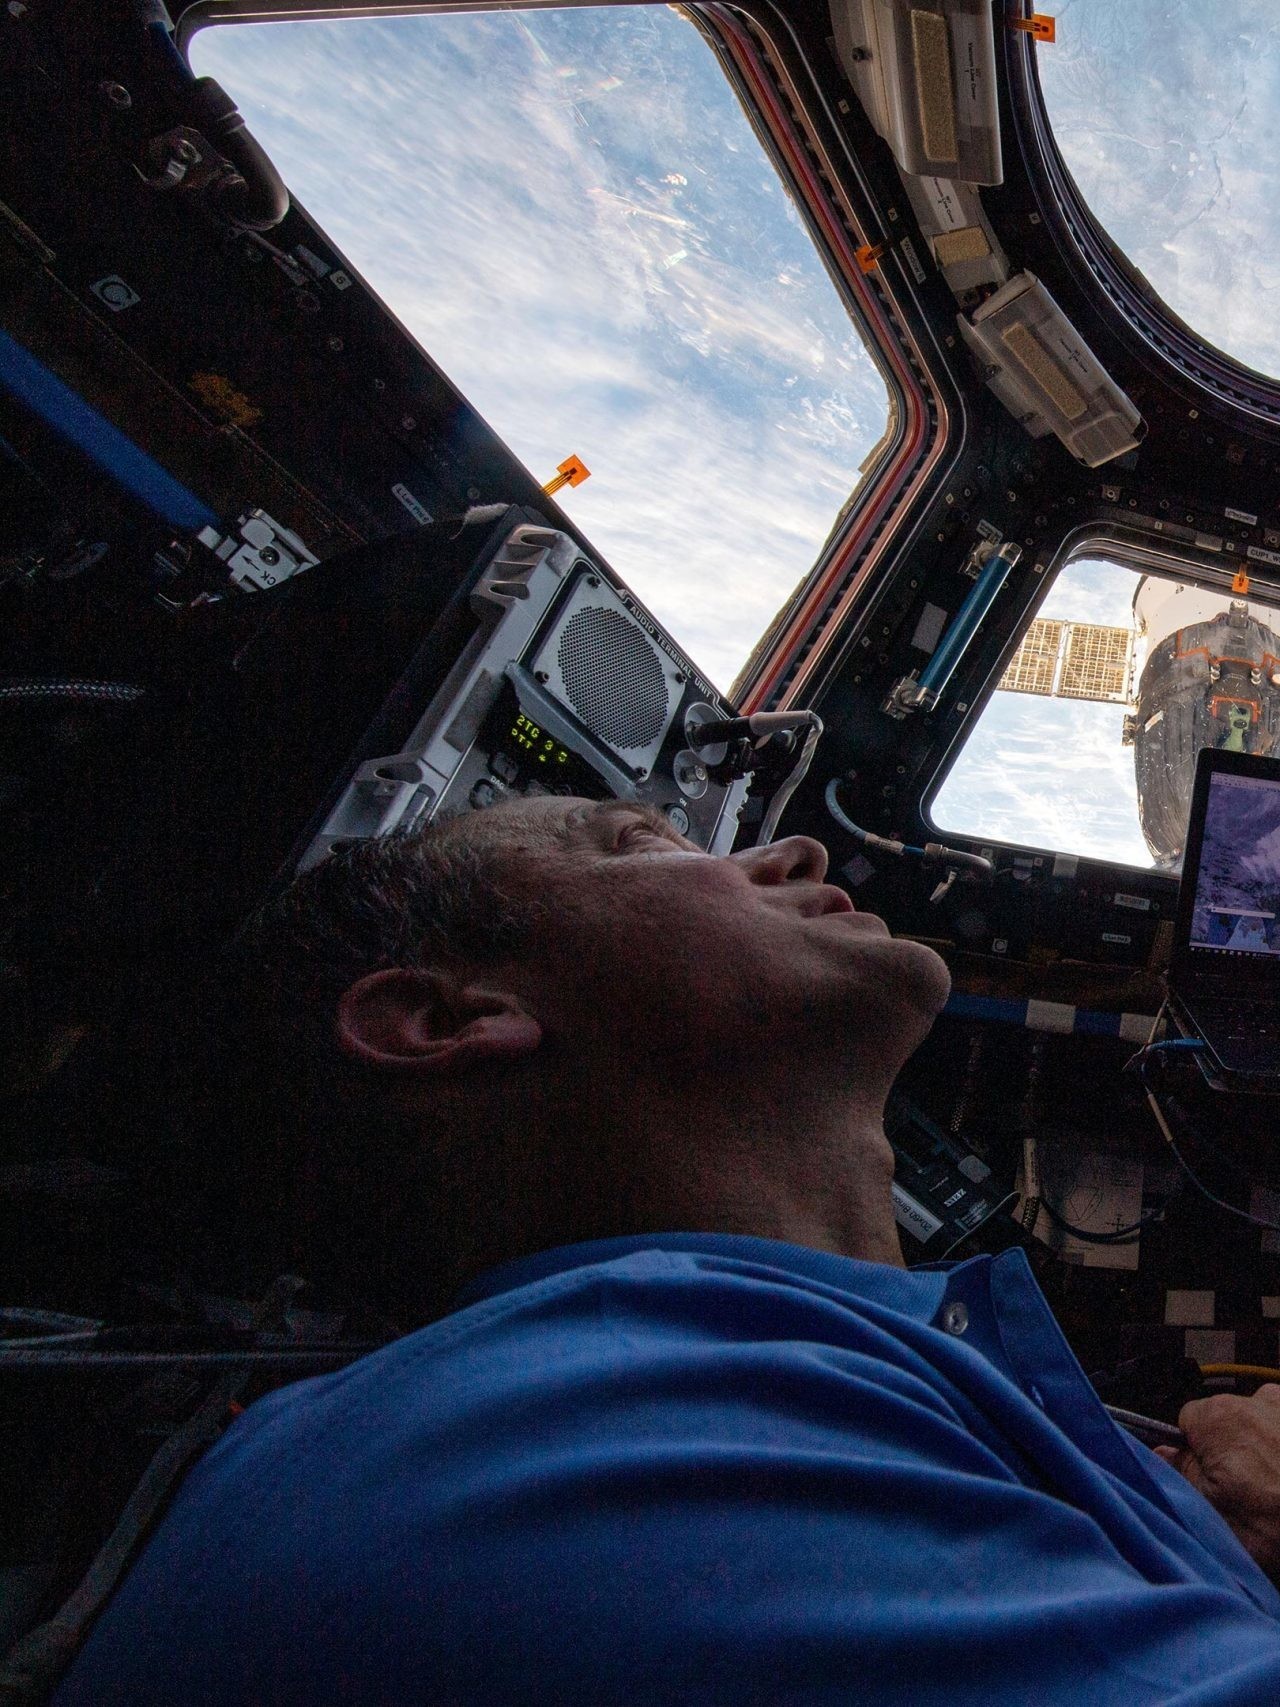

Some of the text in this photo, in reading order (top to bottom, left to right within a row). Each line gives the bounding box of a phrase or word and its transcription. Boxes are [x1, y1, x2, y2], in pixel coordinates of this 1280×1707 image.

[630, 606, 712, 698] AUDIO TERMINAL UNIT
[671, 812, 686, 829] PTT
[909, 1210, 932, 1232] 20x60
